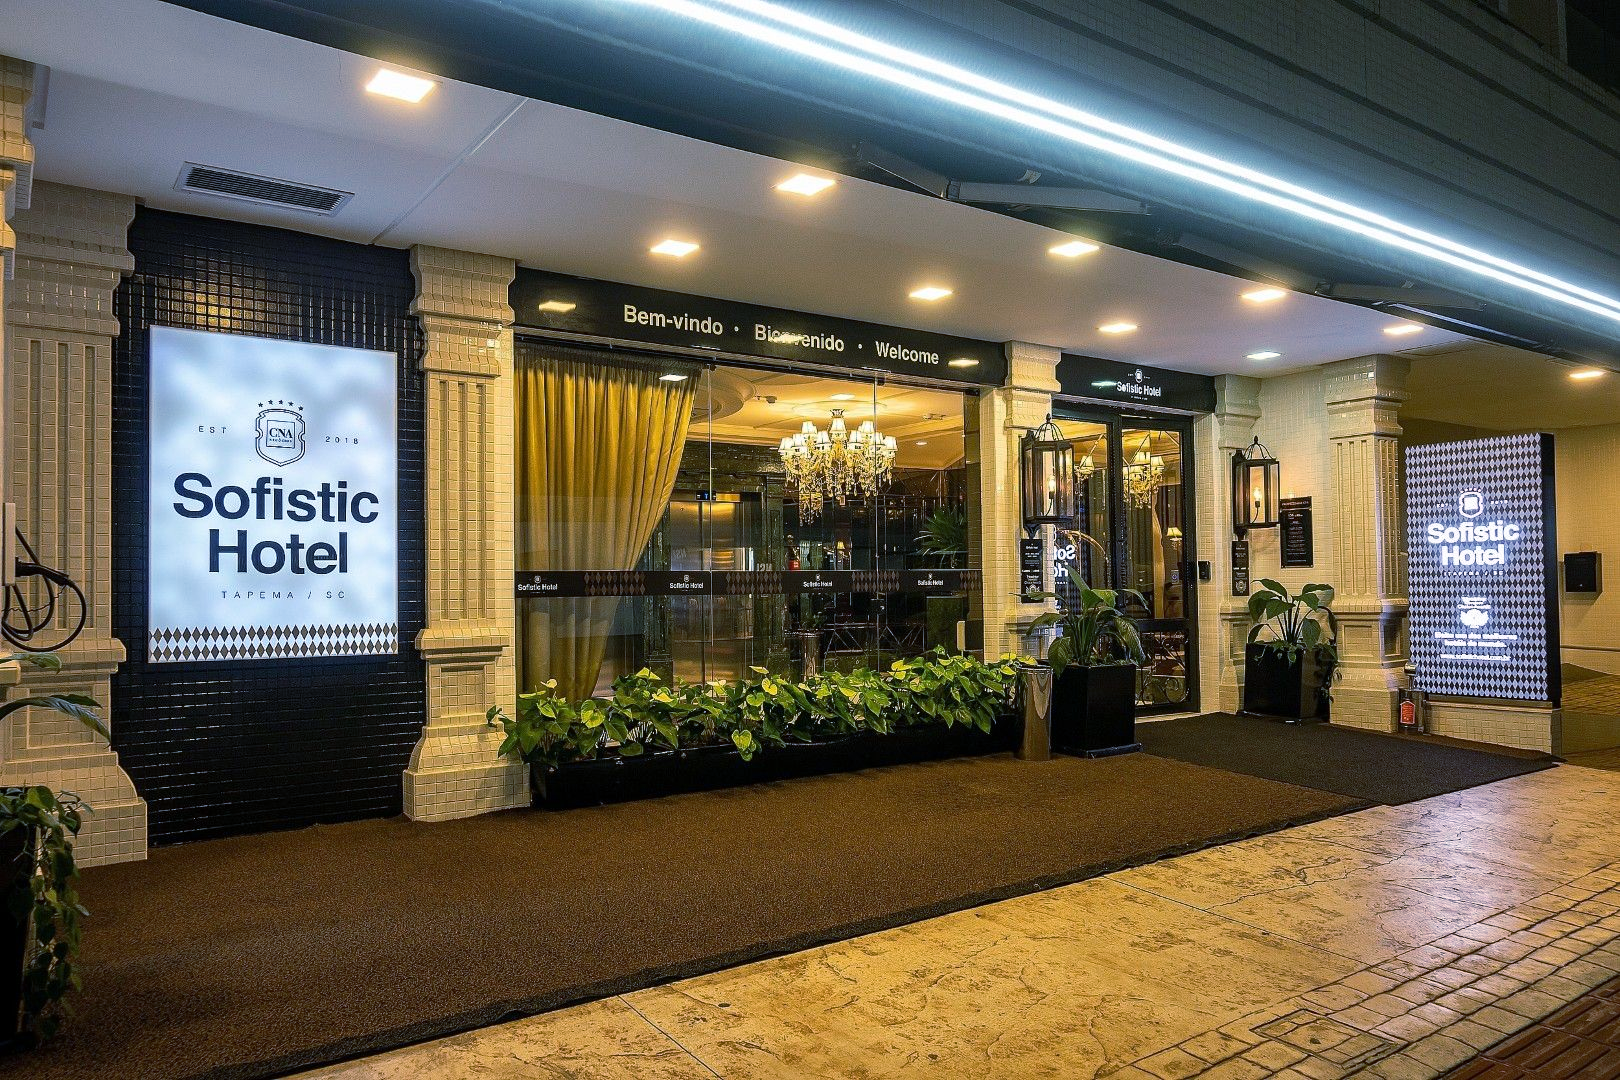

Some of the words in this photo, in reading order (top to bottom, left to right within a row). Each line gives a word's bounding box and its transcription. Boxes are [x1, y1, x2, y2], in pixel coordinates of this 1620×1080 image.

[623, 304, 723, 336] Bem-vindo
[875, 340, 940, 365] Welcome
[1116, 381, 1143, 395] Sofistic
[1143, 384, 1162, 397] Hotel
[198, 425, 228, 435] EST
[325, 435, 359, 445] 2018
[172, 472, 379, 524] Sofistic
[1426, 519, 1520, 544] Sofistic
[208, 528, 348, 575] Hotel
[1441, 543, 1505, 566] Hotel
[325, 590, 345, 599] SC
[541, 583, 558, 591] Hotel
